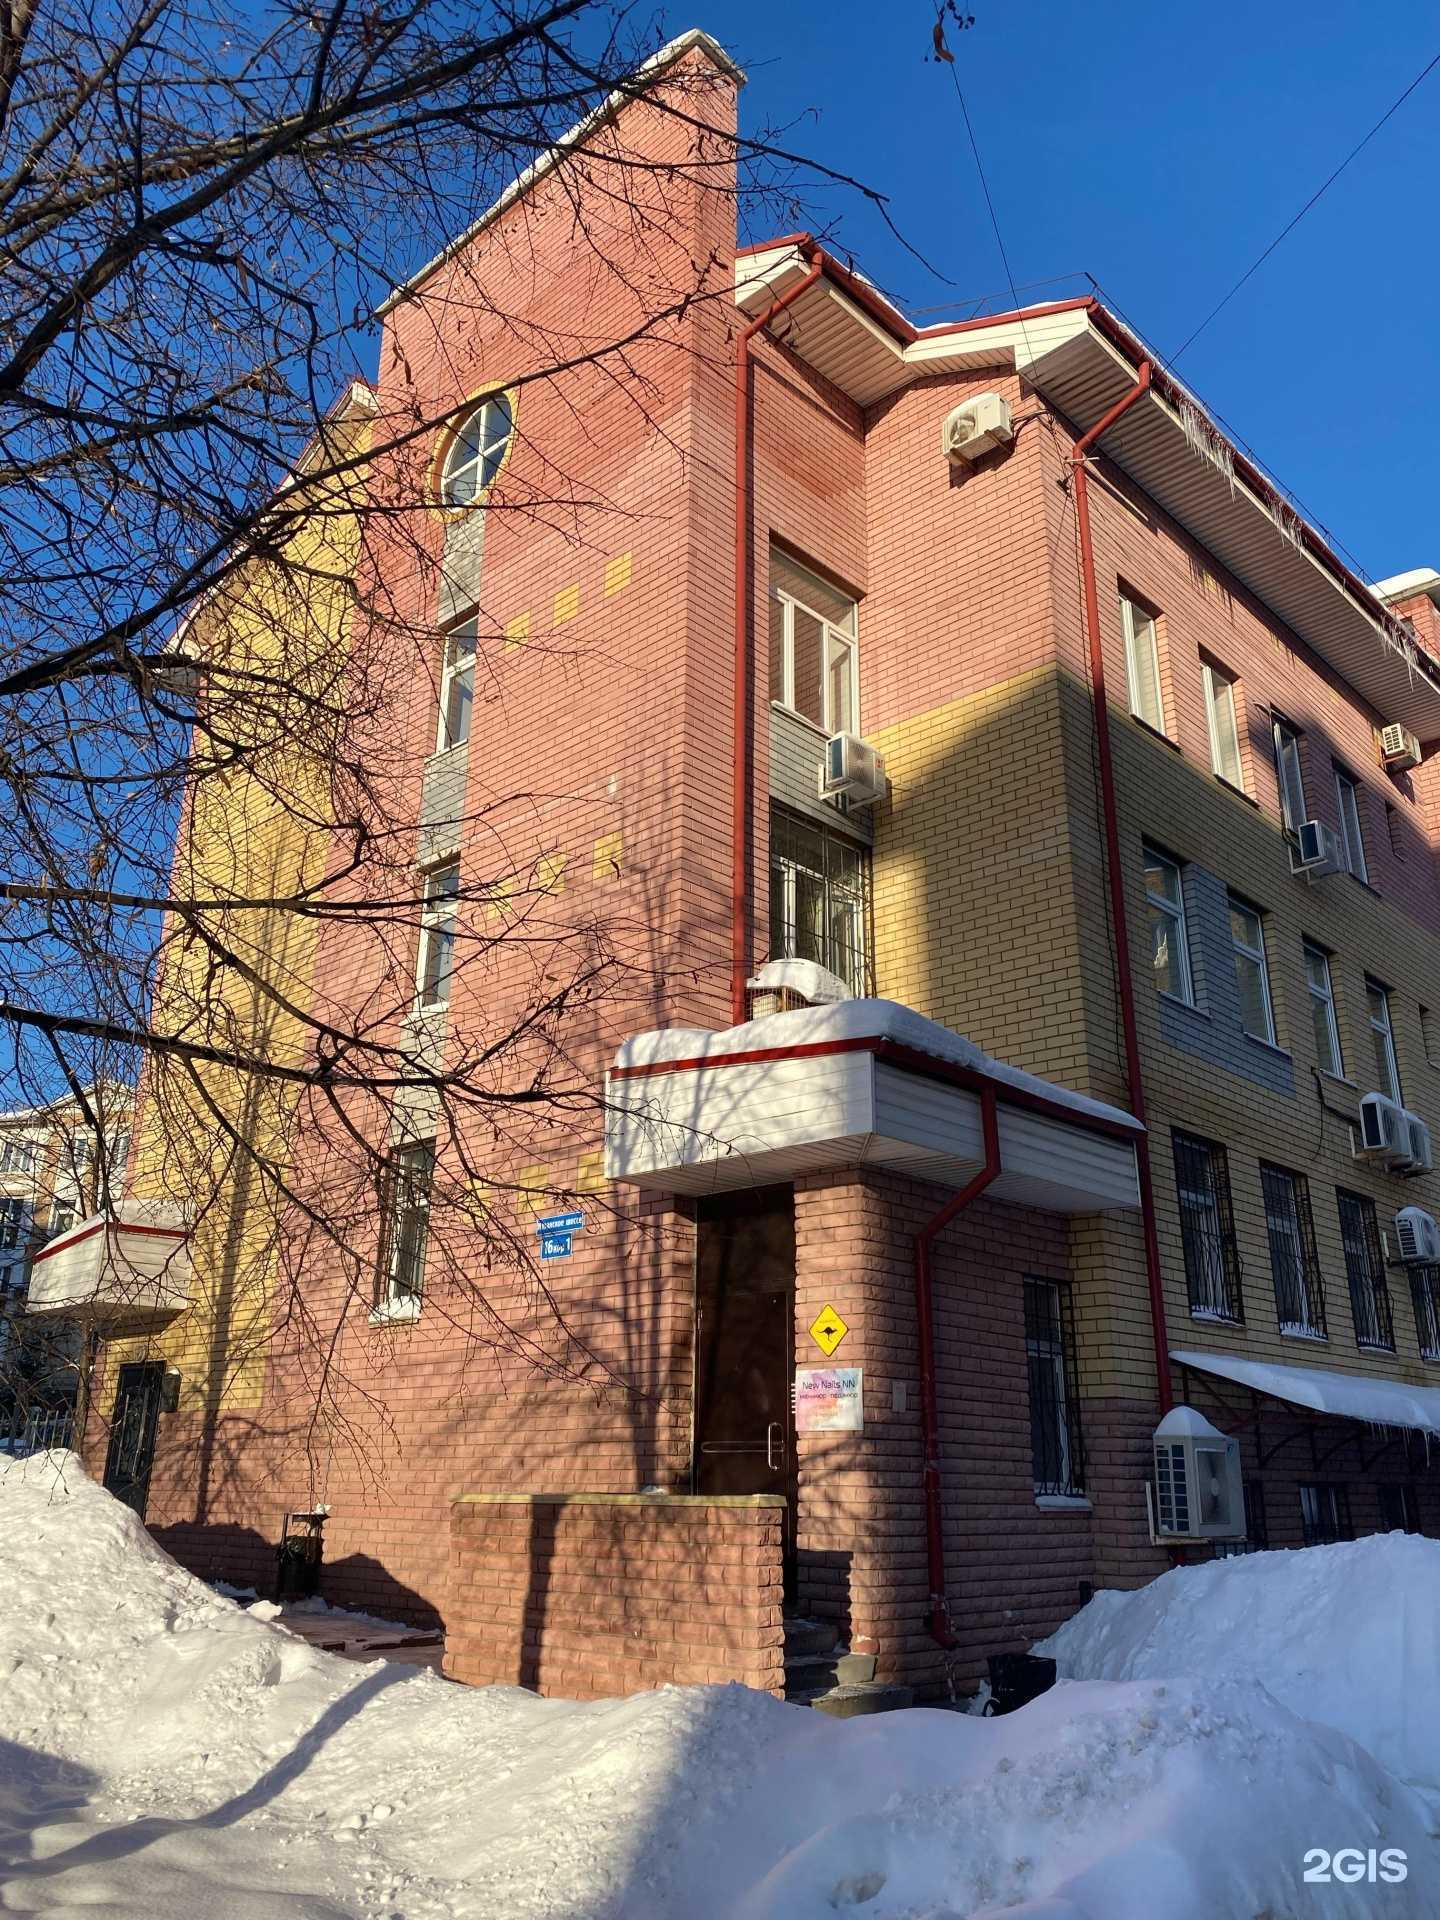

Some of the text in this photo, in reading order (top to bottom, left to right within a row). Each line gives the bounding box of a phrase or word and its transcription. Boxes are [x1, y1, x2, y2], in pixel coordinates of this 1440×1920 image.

[802, 1379, 855, 1390] New Nails NN
